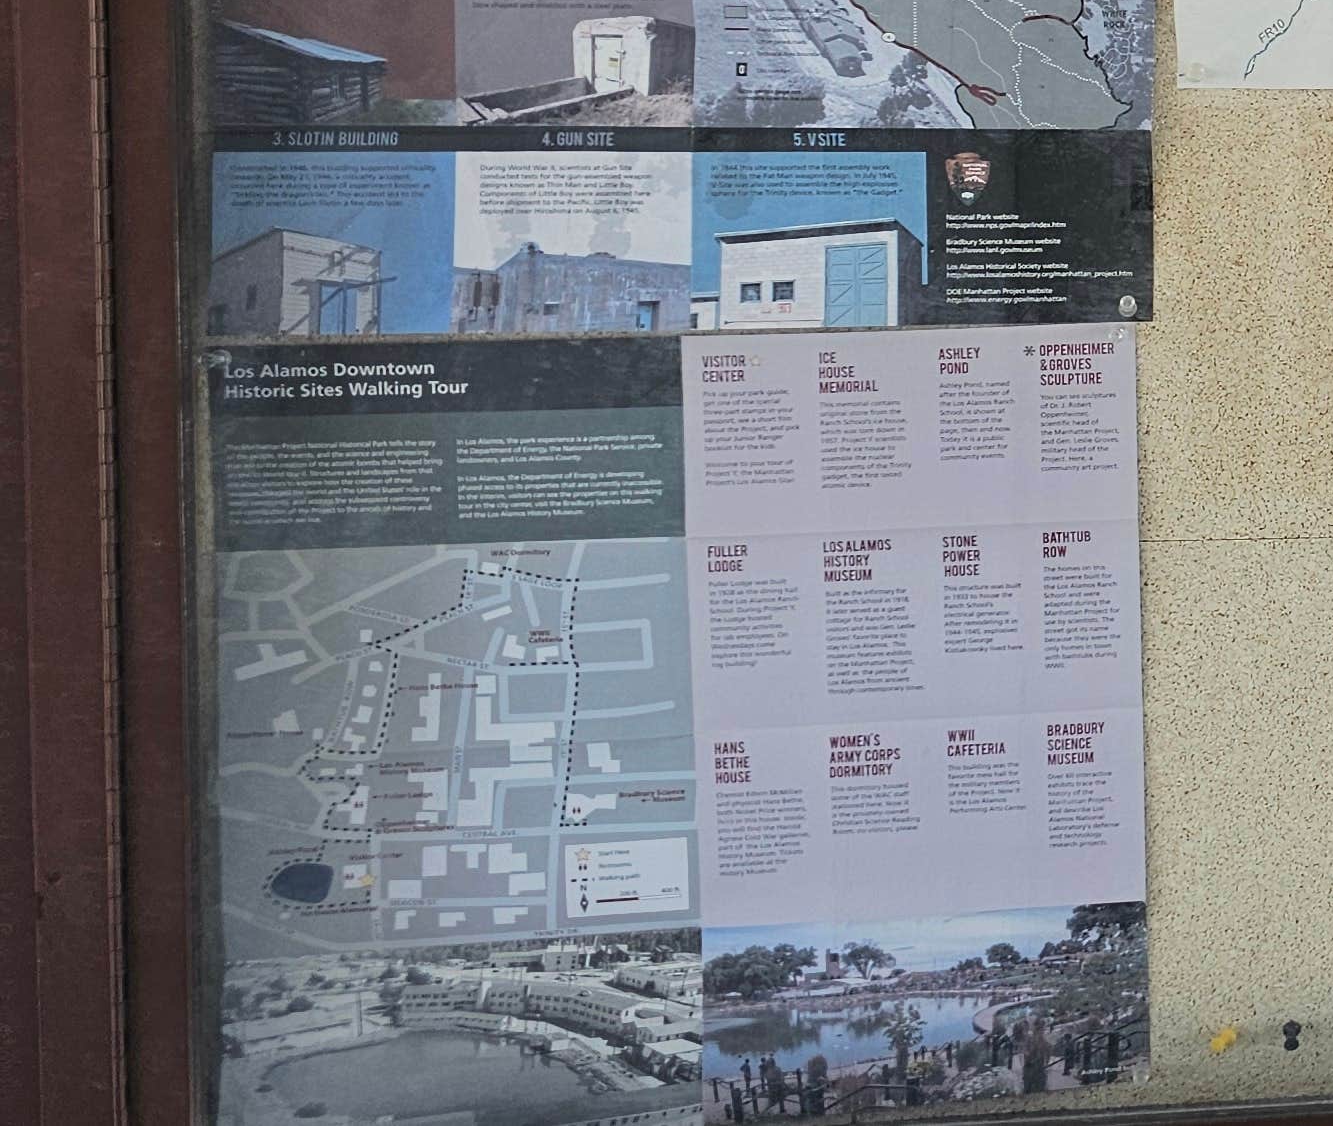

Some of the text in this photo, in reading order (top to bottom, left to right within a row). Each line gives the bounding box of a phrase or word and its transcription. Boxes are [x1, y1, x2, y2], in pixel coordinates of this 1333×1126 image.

[272, 132, 398, 146] 3. SLOTIN BUILDING
[939, 347, 980, 360] ASHLEY
[226, 363, 436, 378] Los Alamos Downtown
[940, 362, 968, 375] POND
[226, 381, 468, 399] Historic Sites Walking Tour
[1043, 531, 1091, 543] BATHTUB
[1043, 546, 1066, 558] ROW
